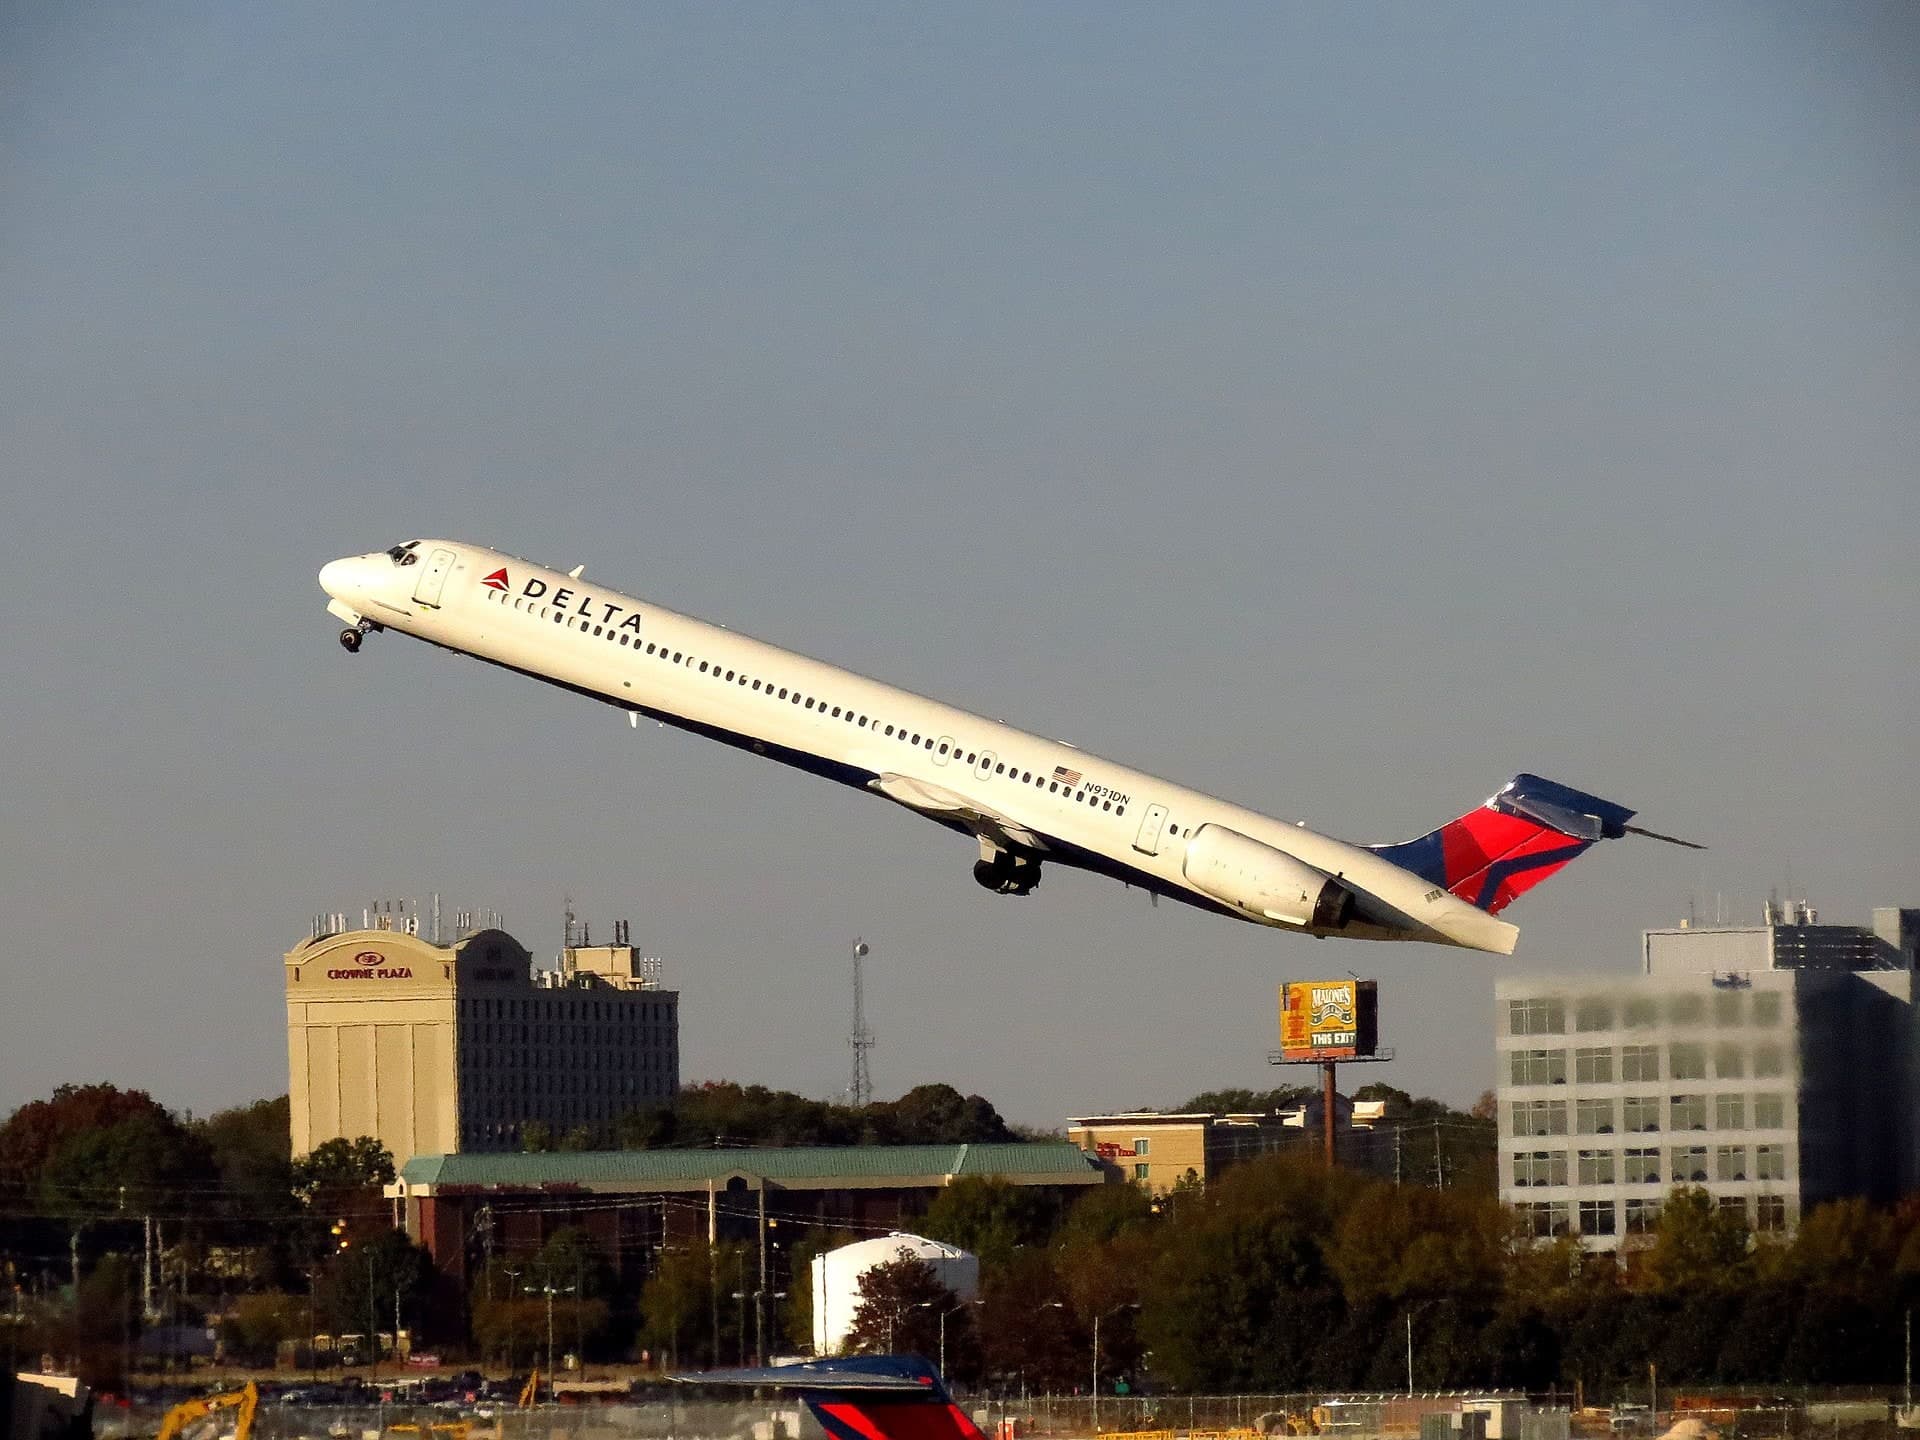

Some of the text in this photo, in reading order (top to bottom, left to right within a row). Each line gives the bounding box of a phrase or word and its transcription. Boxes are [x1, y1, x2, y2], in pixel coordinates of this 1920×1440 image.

[522, 578, 642, 633] DELTA
[1084, 782, 1130, 804] N931DN
[327, 967, 412, 979] CROWNE PLAZA
[1312, 1034, 1332, 1045] THIS
[1334, 1033, 1355, 1044] EXIT
